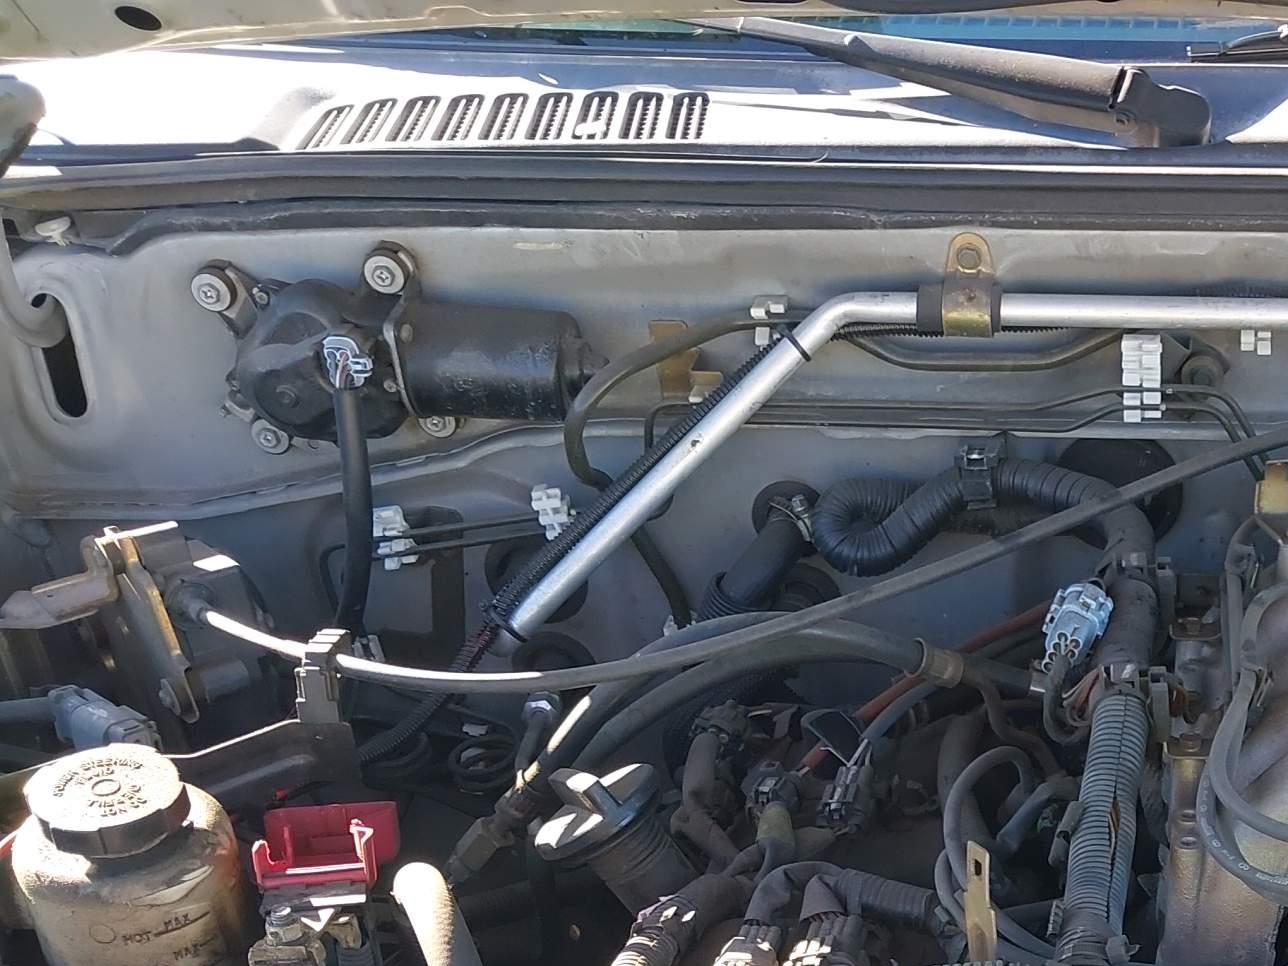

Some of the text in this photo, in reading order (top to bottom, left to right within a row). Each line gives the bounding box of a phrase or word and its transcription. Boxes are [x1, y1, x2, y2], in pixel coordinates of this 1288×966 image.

[121, 913, 191, 946] HOT MAX
[173, 942, 201, 960] MAX
